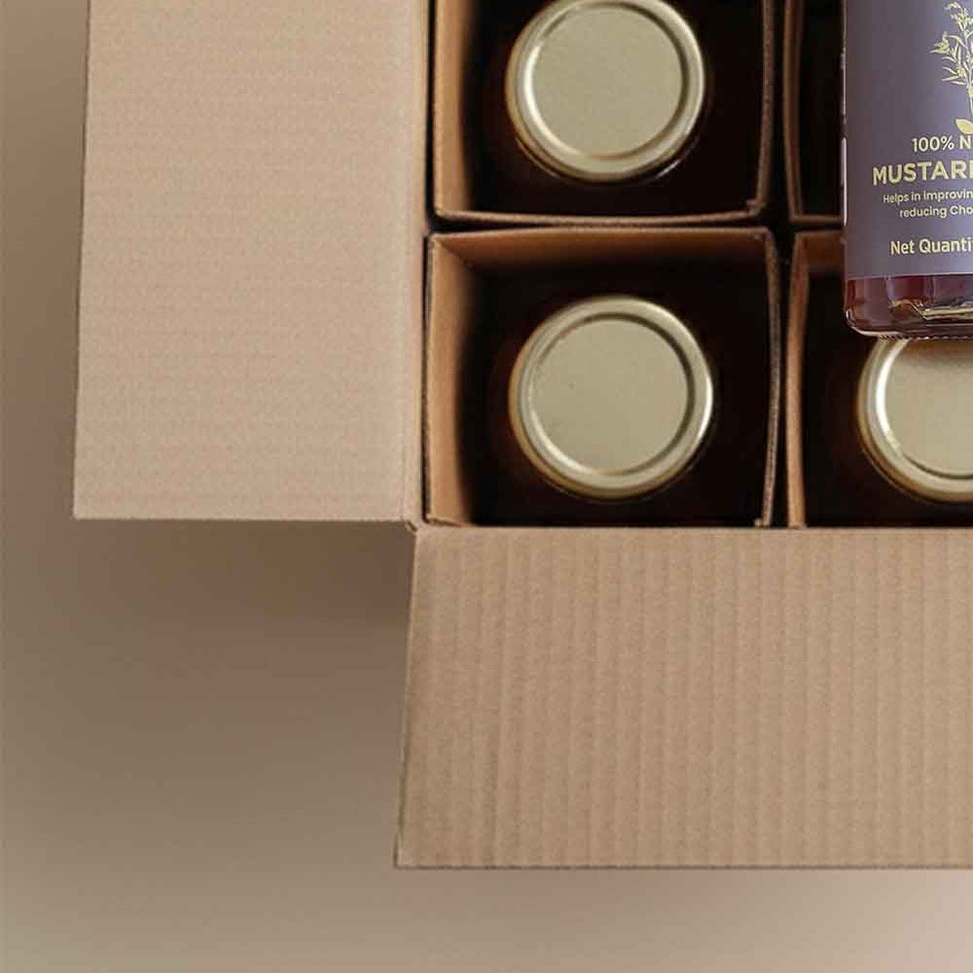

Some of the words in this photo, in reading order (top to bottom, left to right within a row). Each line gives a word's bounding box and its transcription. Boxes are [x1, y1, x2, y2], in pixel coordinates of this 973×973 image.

[912, 136, 954, 152] 100%
[883, 193, 909, 205] Helps
[911, 192, 921, 201] in
[900, 207, 946, 218] reducing
[891, 240, 915, 255] Net
